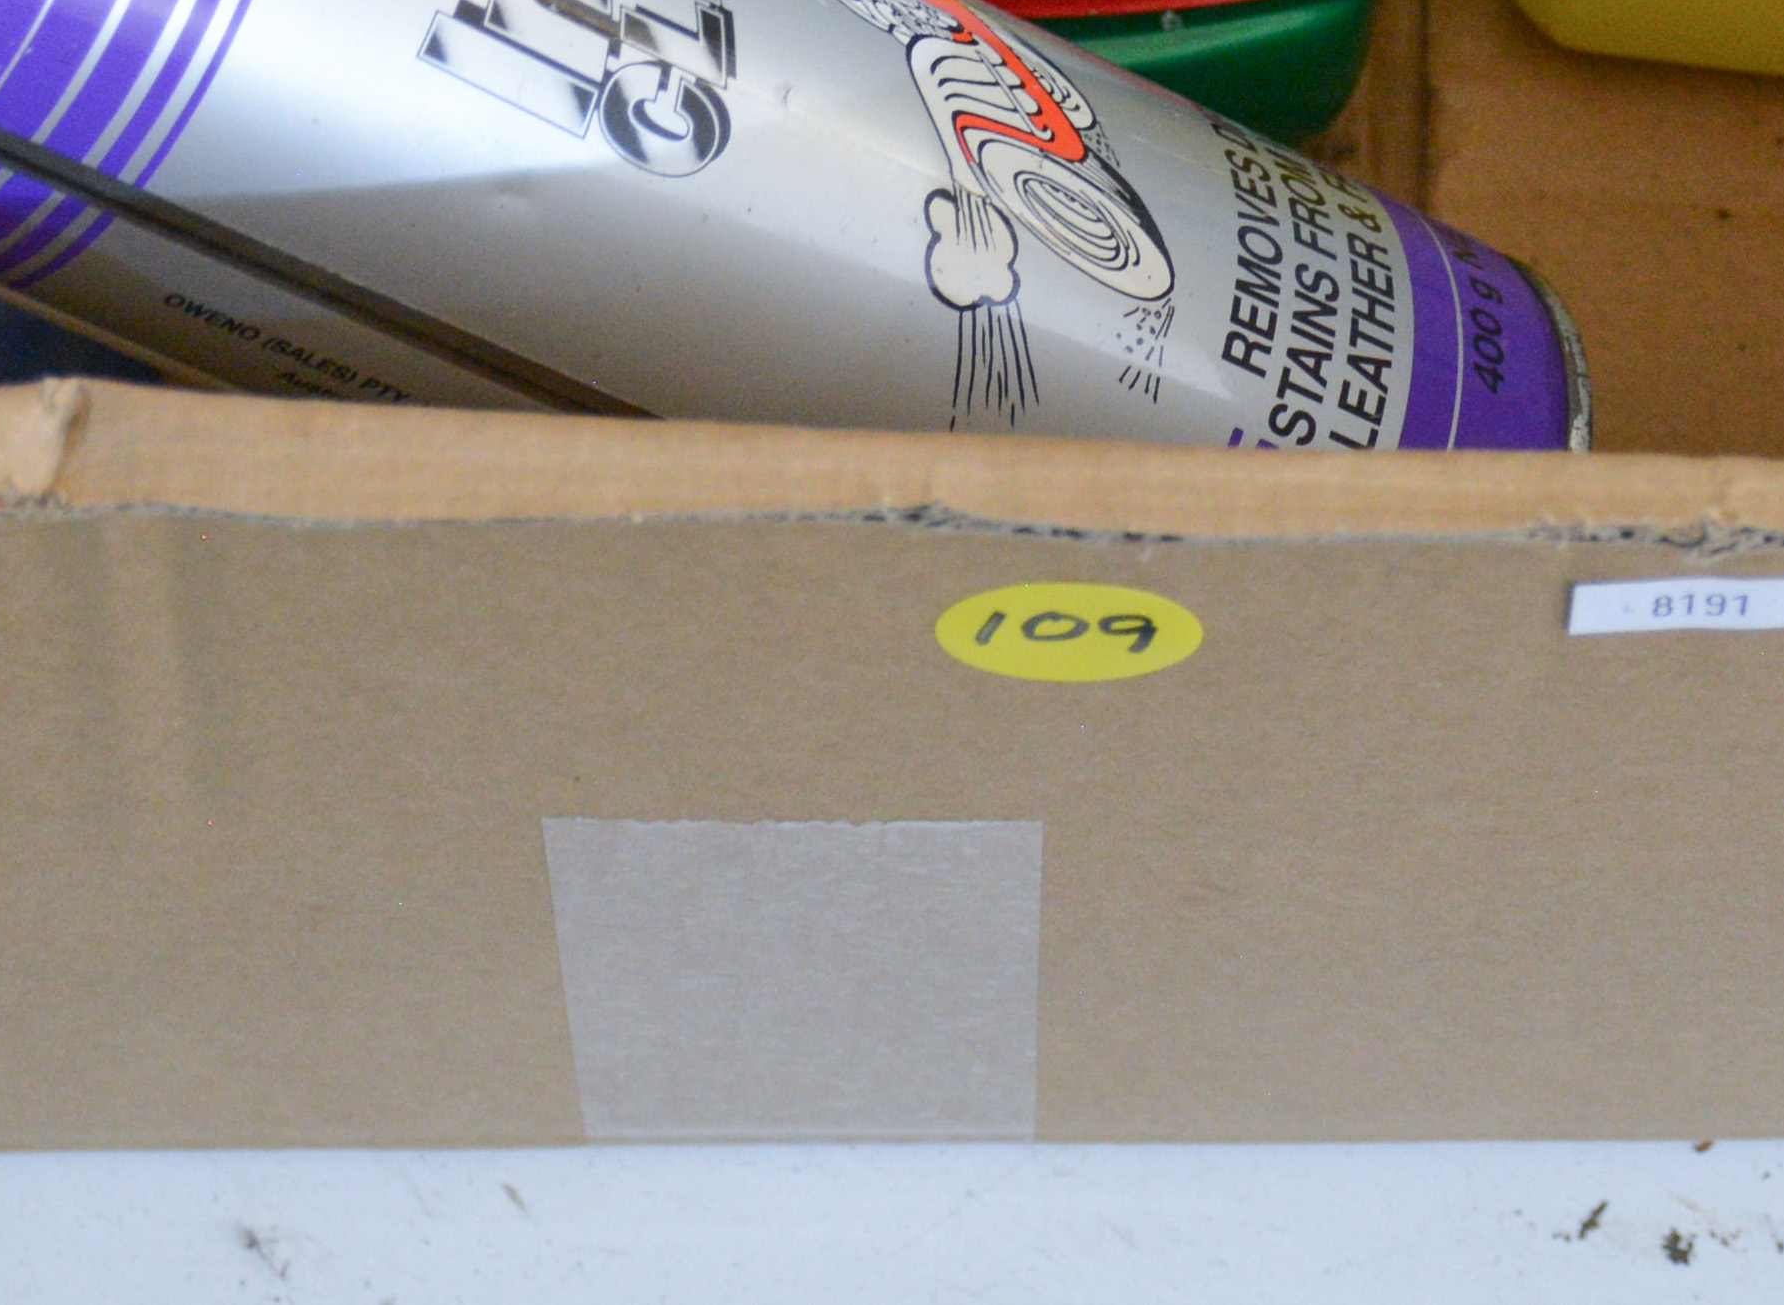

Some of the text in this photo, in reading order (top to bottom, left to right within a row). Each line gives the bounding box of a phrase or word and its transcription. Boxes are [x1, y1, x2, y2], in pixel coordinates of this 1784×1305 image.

[1338, 202, 1382, 234] &
[1221, 148, 1283, 379] REMOVES
[1266, 147, 1340, 446] STAINS FROM
[1469, 277, 1504, 305] g
[1328, 232, 1395, 450] LEATHER
[1469, 306, 1505, 394] 400
[975, 609, 1158, 654] 109
[1652, 593, 1753, 620] 8191
